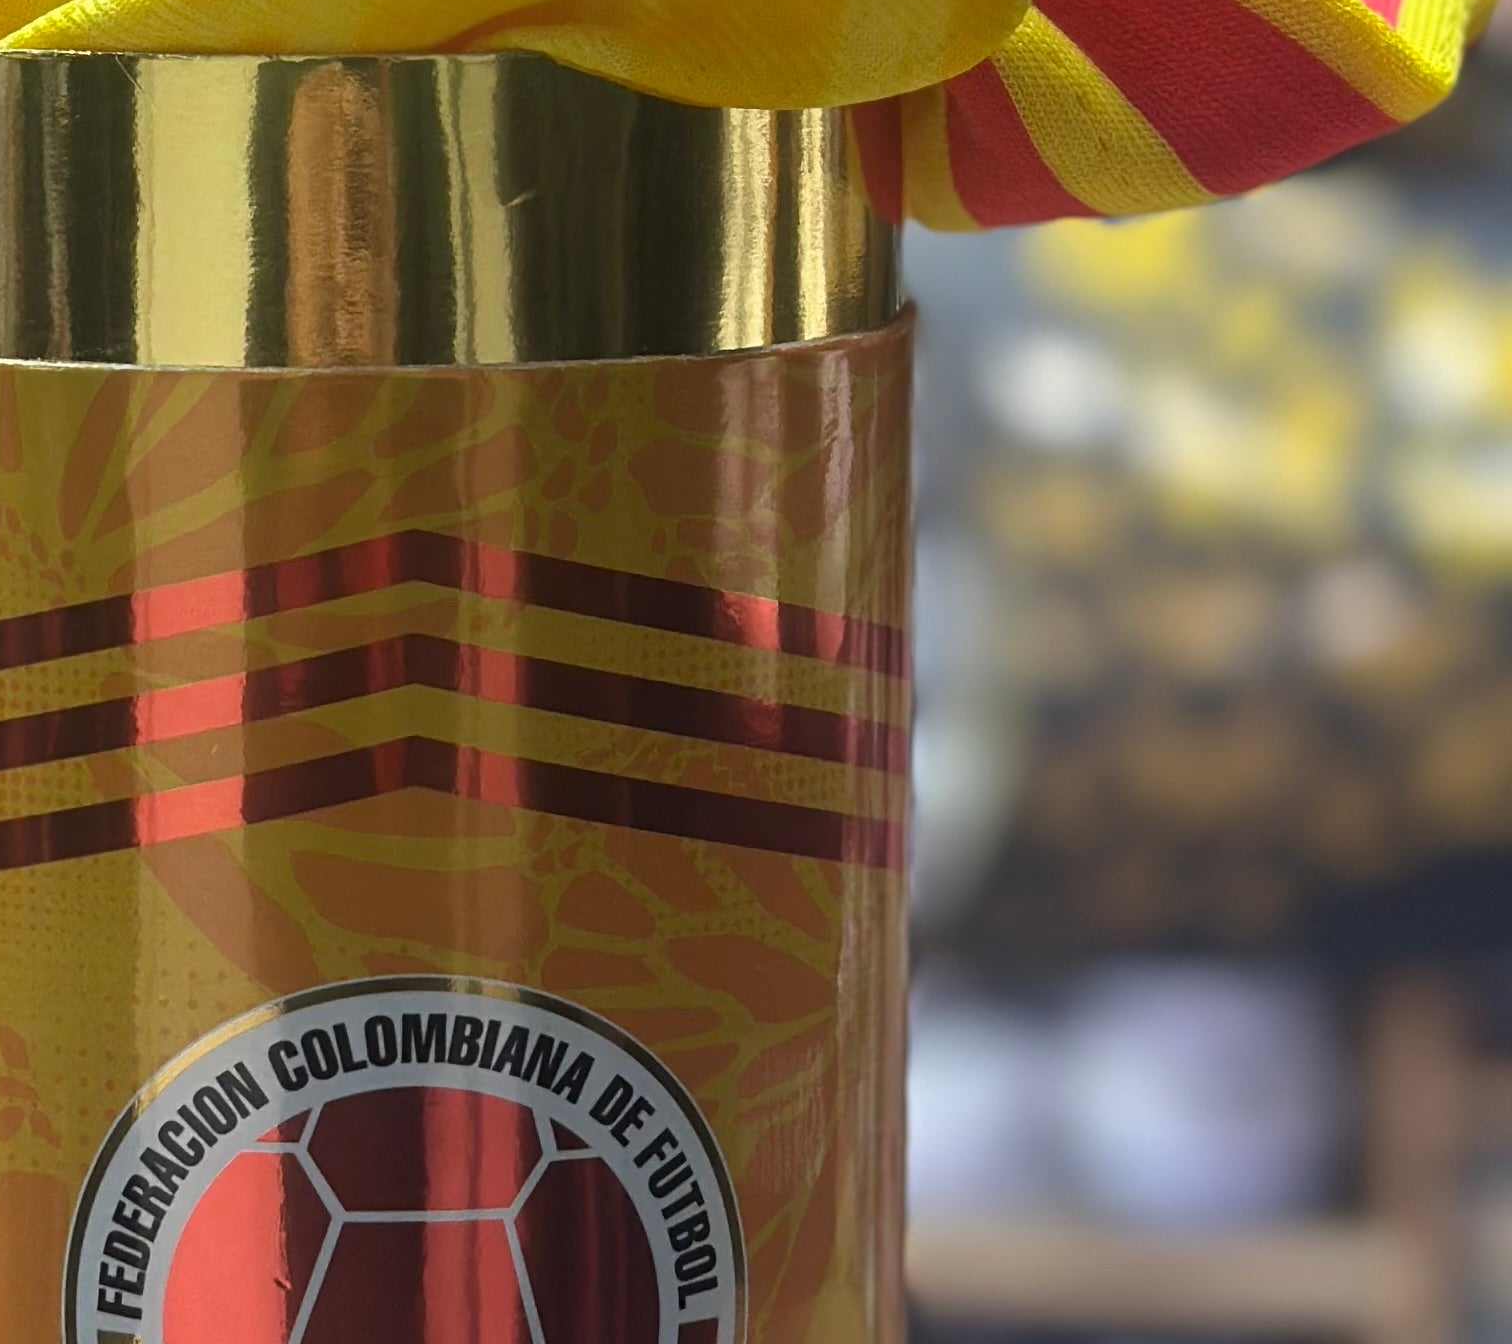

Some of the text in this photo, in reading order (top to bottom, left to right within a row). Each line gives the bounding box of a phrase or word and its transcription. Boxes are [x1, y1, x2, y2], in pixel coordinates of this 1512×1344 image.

[96, 1012, 719, 1320] FEDERACION COLOMBIANA DE FUTBOL
